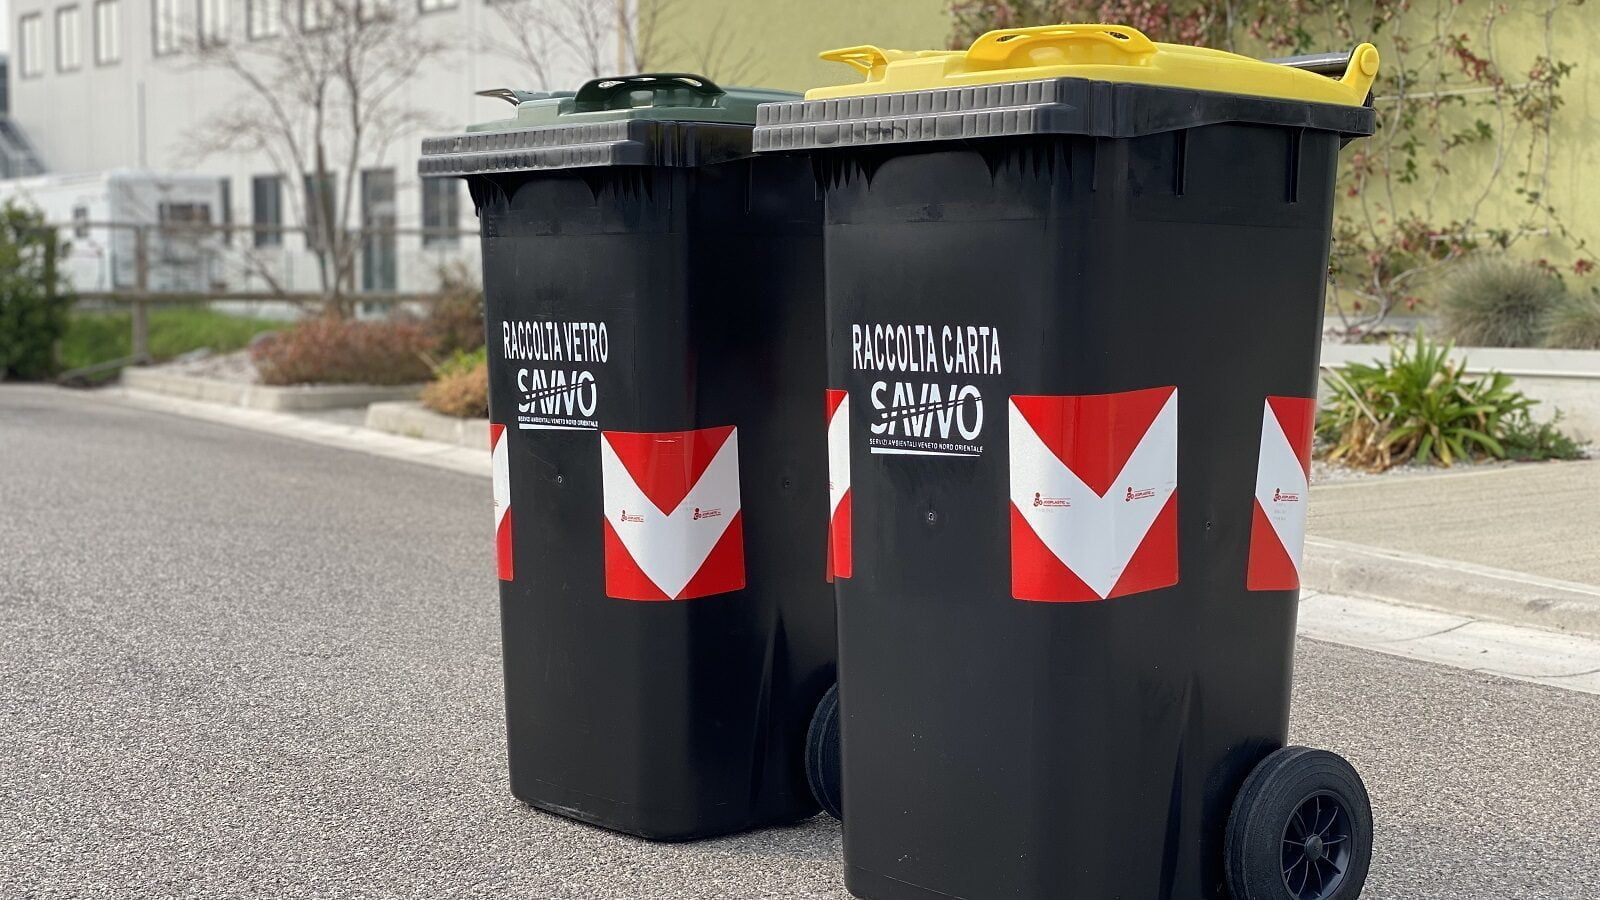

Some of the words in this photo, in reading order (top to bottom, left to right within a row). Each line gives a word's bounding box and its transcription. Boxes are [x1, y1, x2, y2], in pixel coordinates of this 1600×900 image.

[502, 321, 562, 361] RACCOLTA
[563, 321, 609, 363] VETRO
[852, 323, 938, 373] RACCOLTA
[941, 325, 1002, 375] CARTA
[517, 368, 597, 417] SAVNO
[870, 380, 984, 441] SAVNO
[918, 441, 938, 450] VENETO
[939, 442, 954, 451] NORD
[954, 444, 984, 453] ORIENTALE
